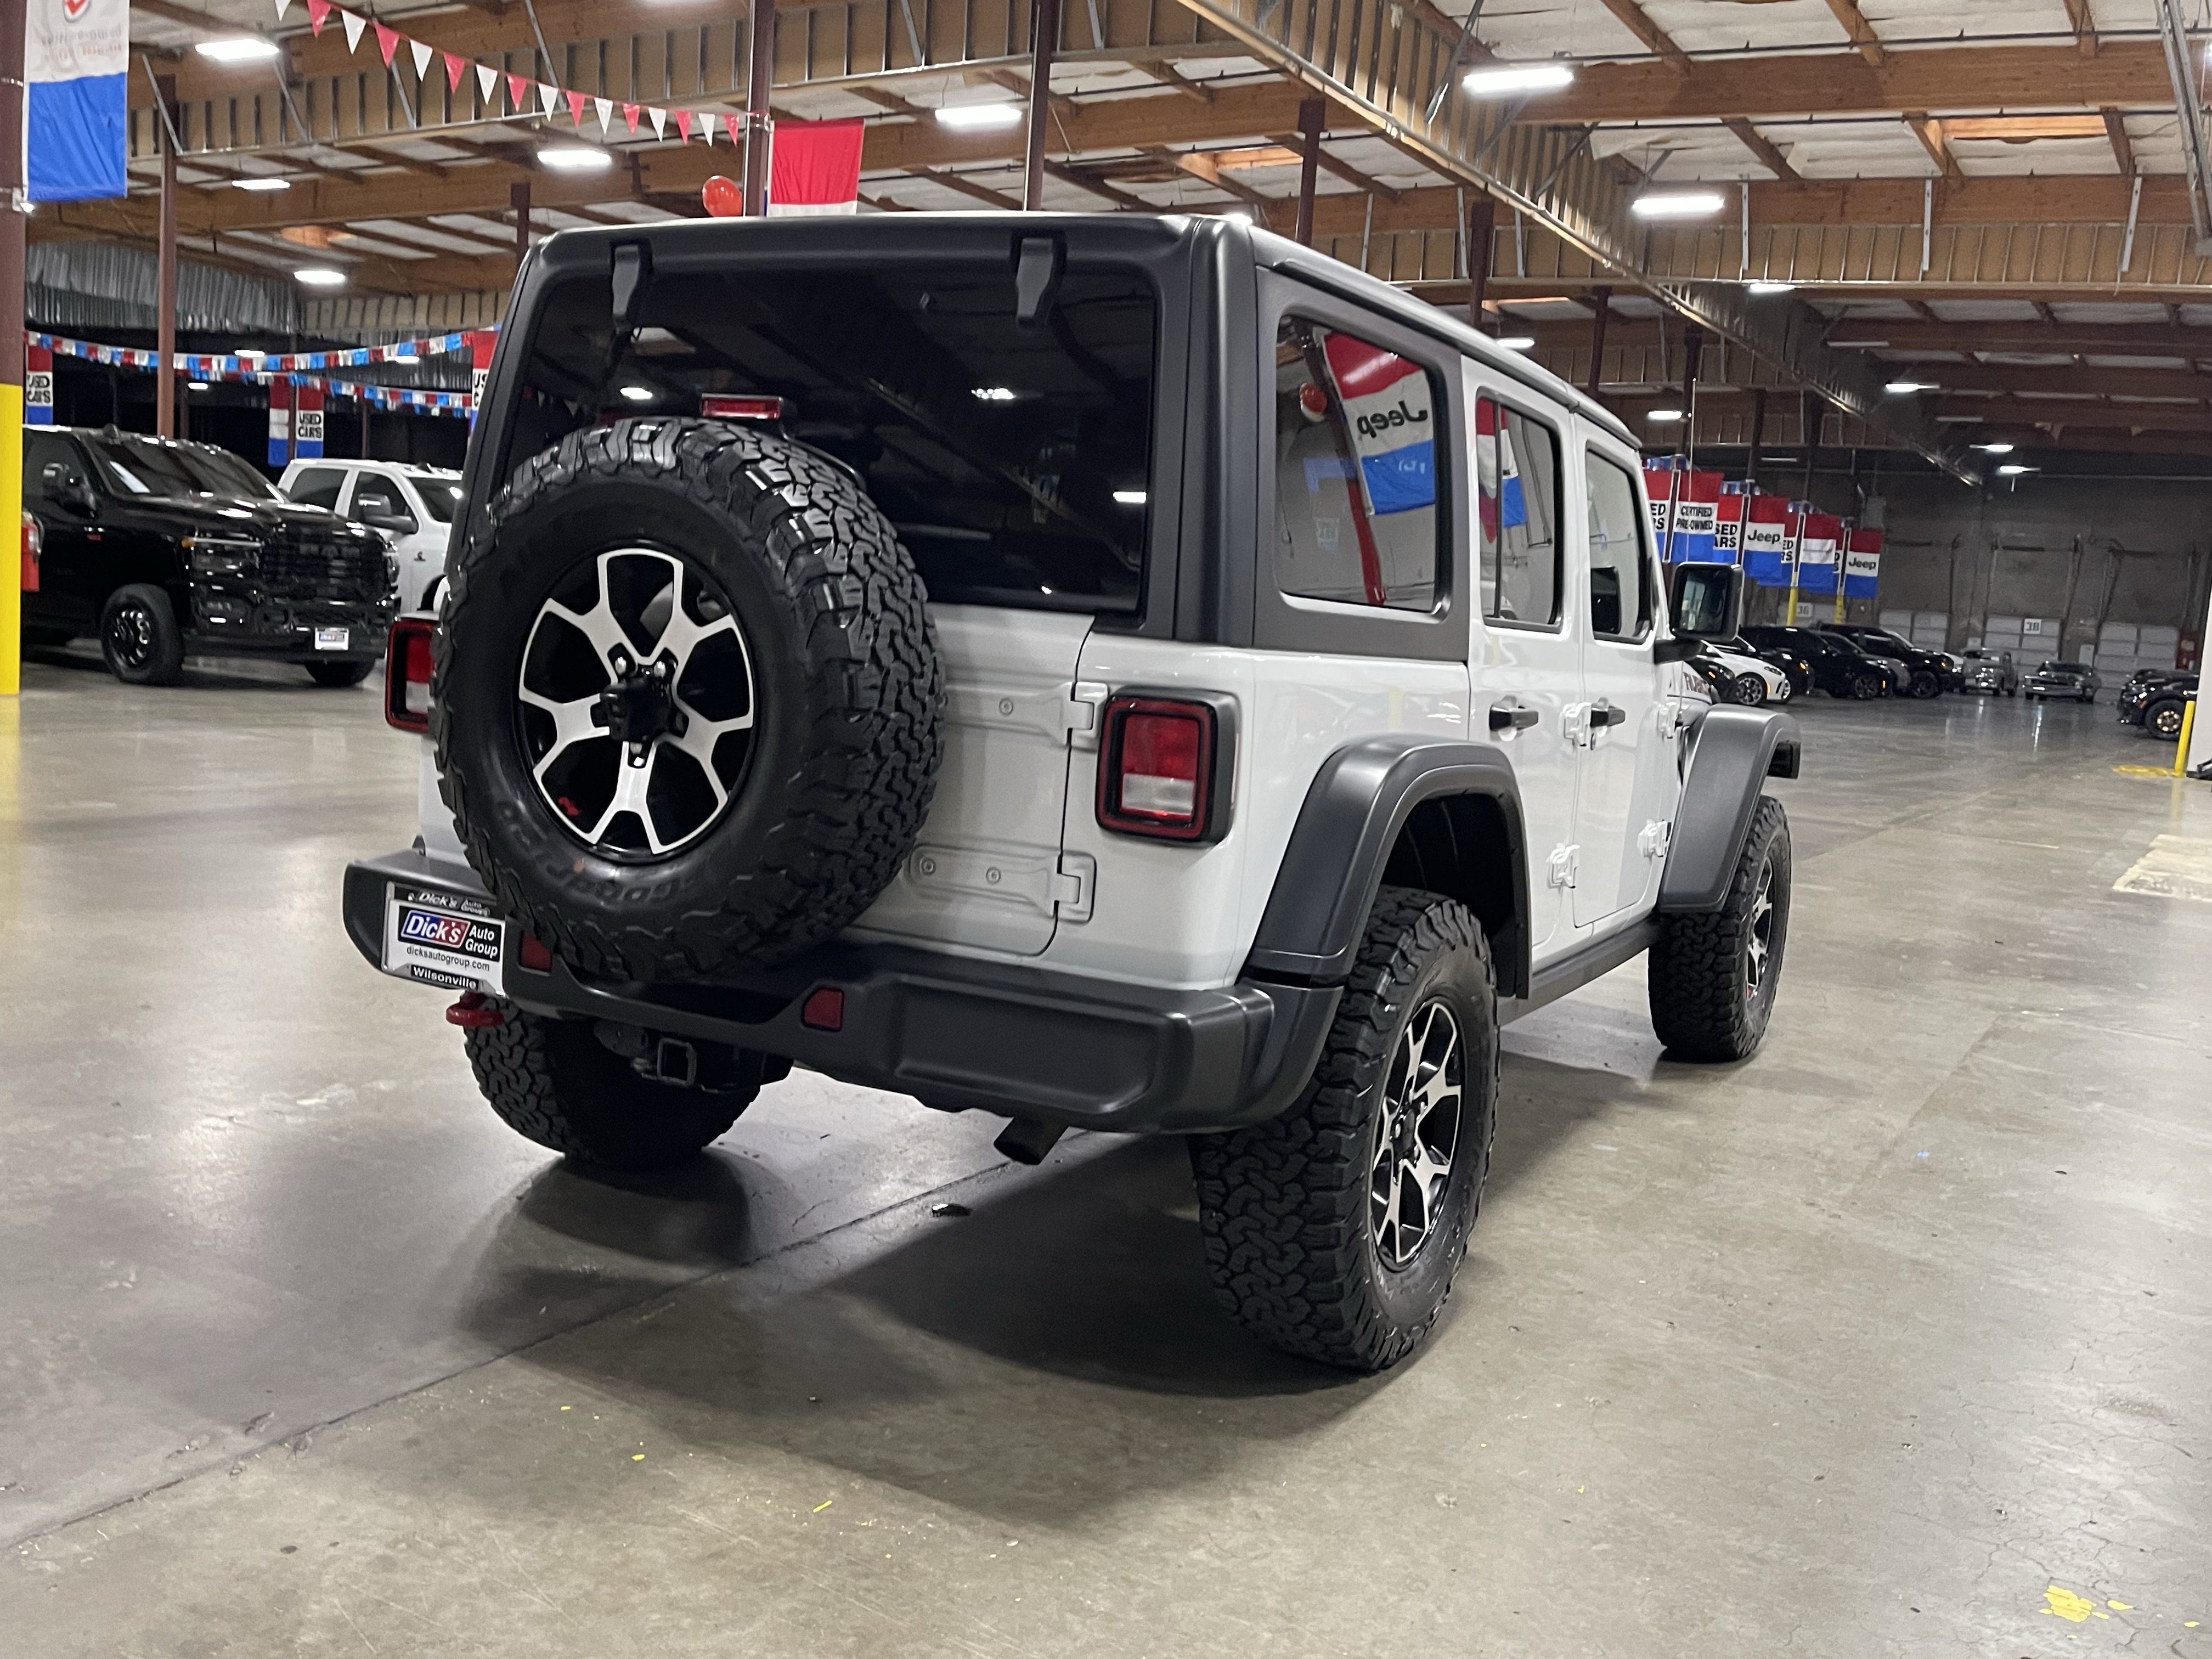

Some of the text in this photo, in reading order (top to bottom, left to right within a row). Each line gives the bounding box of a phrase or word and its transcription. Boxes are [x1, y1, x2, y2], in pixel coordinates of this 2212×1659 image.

[1650, 503, 1666, 516] ED
[1716, 523, 1737, 535] SED
[1747, 529, 1781, 545] Jeep
[1715, 537, 1736, 548] RS
[1783, 539, 1793, 550] ED
[1848, 557, 1876, 570] Jeep
[407, 915, 461, 943] Dick's
[469, 925, 494, 941] Auto
[465, 938, 498, 959] Group
[407, 946, 490, 972] dicksautogroup.com
[413, 966, 477, 989] Wilsonville
